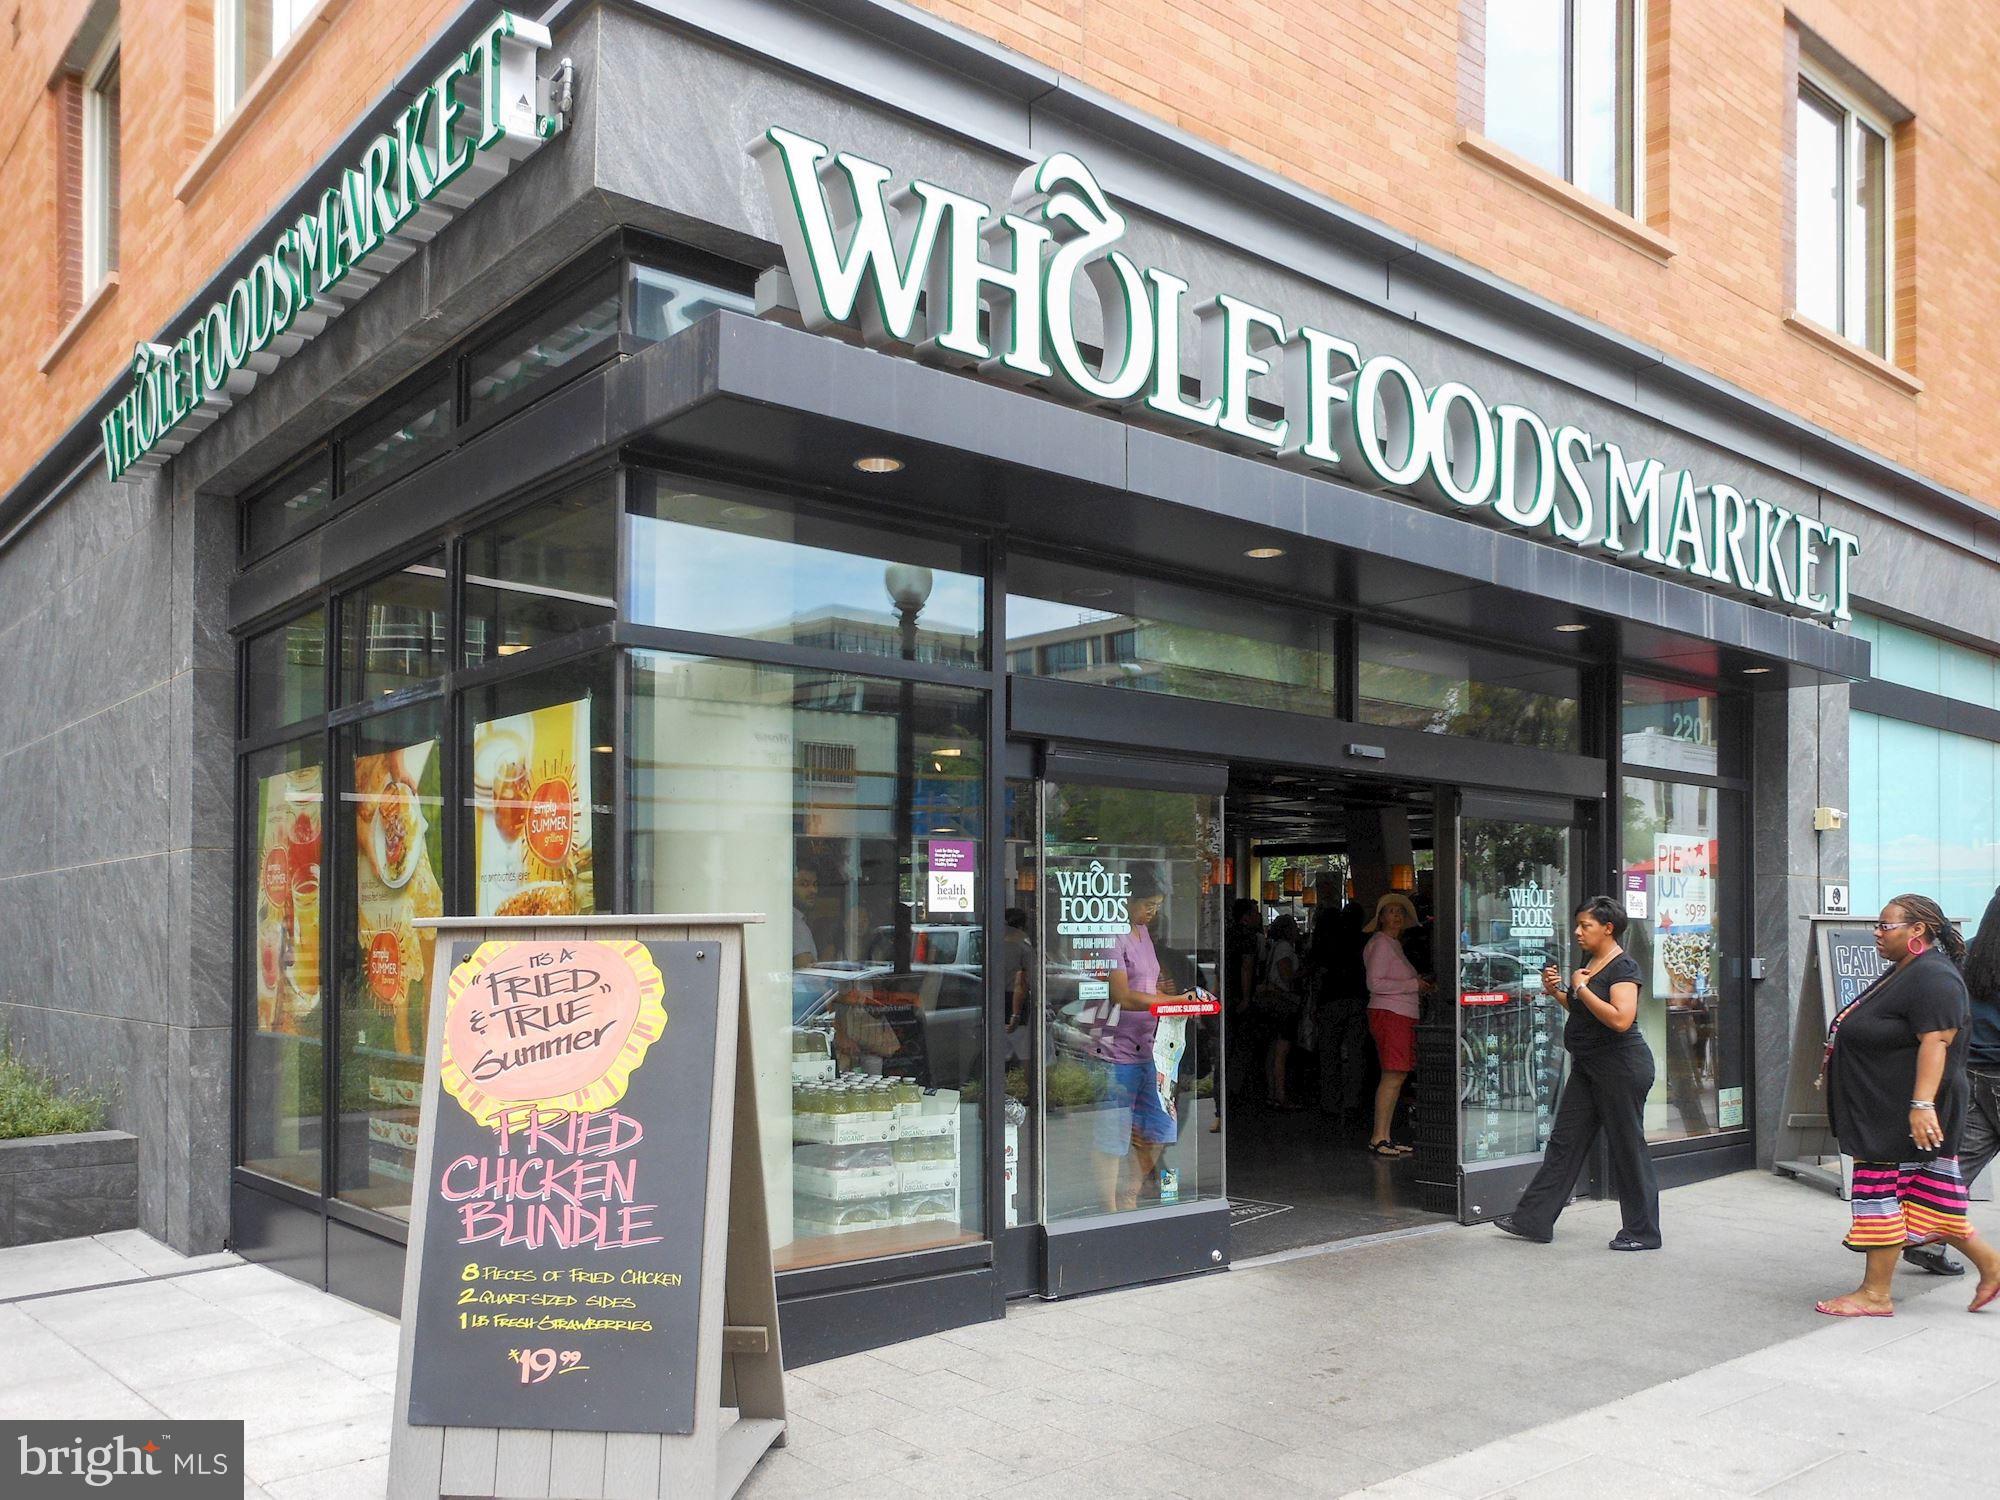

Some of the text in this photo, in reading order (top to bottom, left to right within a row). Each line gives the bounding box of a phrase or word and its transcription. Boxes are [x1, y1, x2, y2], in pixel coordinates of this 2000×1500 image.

[101, 10, 513, 482] WHOLE FOODS MARKET
[766, 125, 1861, 622] WHOLE FOODS MARKET
[1673, 712, 1711, 746] 2201
[532, 816, 568, 833] SUMMER
[1659, 845, 1681, 873] PIE
[266, 873, 287, 885] SUMMER
[937, 884, 966, 895] health
[1055, 860, 1132, 897] WHOLE
[1657, 876, 1688, 906] JULY
[1509, 880, 1555, 907] WHOLE
[1060, 897, 1129, 923] FOODS
[1511, 908, 1553, 927] FOODS
[372, 962, 398, 975] SUMMER
[560, 948, 577, 963] A
[1841, 979, 1857, 1006] &
[469, 1009, 489, 1035] &
[472, 1020, 617, 1081] Summer
[486, 1103, 644, 1157] FRIED
[839, 1134, 865, 1142] ORGANIC
[901, 1129, 926, 1137] ORGANIC
[441, 1154, 637, 1207] CHICKEN
[904, 1183, 929, 1192] ORGANIC
[457, 1200, 664, 1250] BUNDLE
[461, 1263, 480, 1281] 8
[457, 1288, 478, 1305] 2
[458, 1312, 468, 1329] 1
